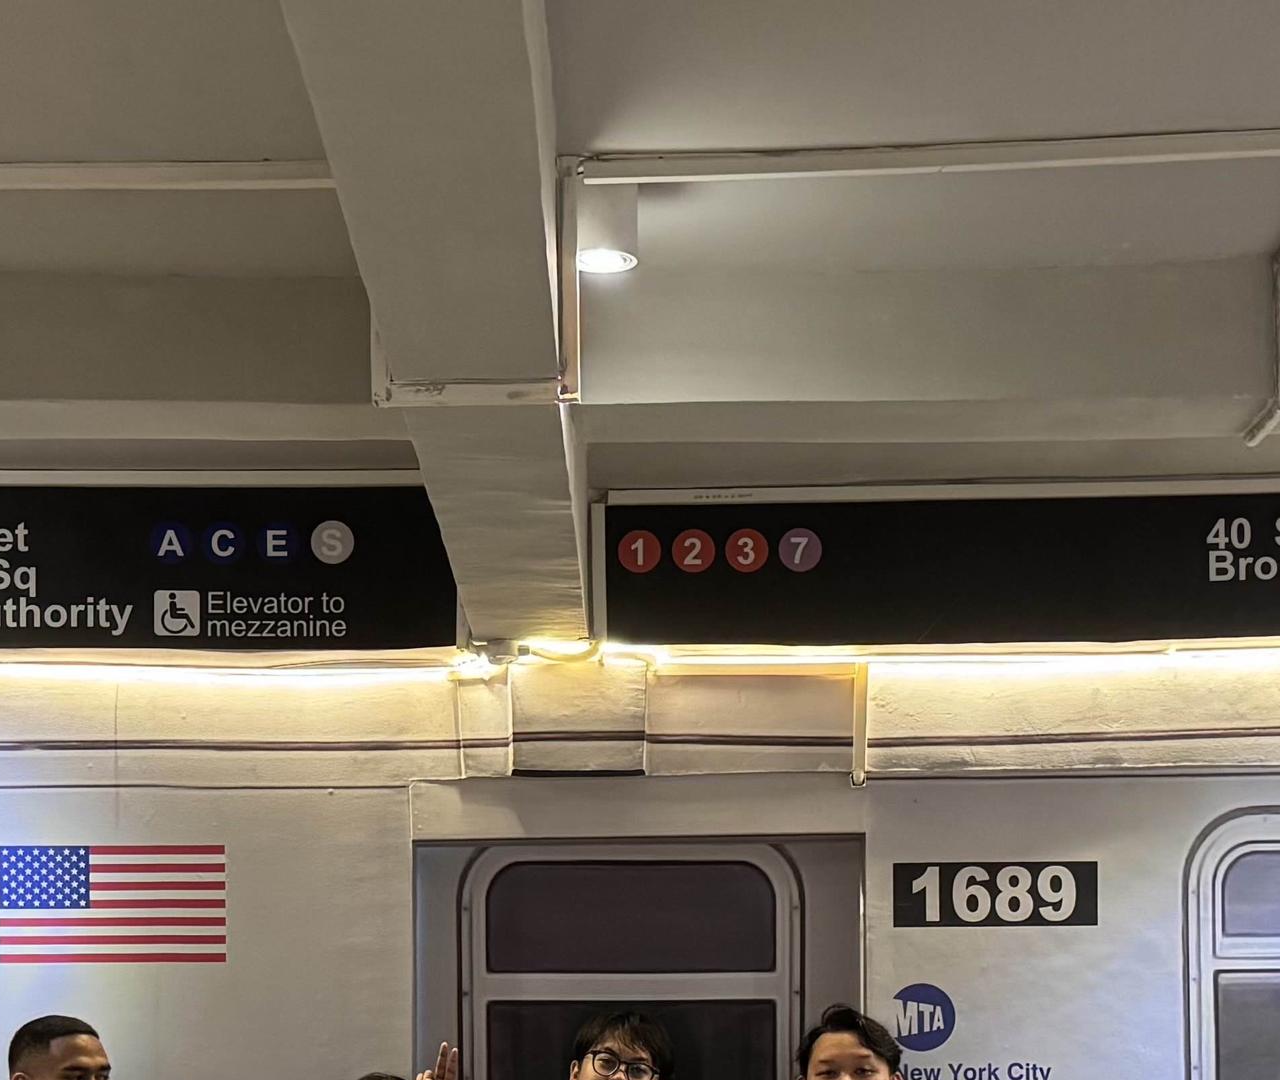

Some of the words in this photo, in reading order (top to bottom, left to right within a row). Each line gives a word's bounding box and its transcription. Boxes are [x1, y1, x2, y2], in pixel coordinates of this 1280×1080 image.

[157, 529, 185, 557] A
[211, 529, 235, 557] C
[266, 529, 288, 557] E
[321, 529, 342, 557] S
[1206, 517, 1252, 550] 40
[631, 537, 644, 566] 1
[683, 537, 703, 566] 2
[736, 537, 756, 566] 3
[791, 537, 810, 566] 7
[207, 591, 314, 614] Elevator
[320, 592, 345, 614] to
[207, 615, 347, 638] mezzanine
[911, 864, 1078, 923] 1689
[893, 999, 946, 1038] MTA
